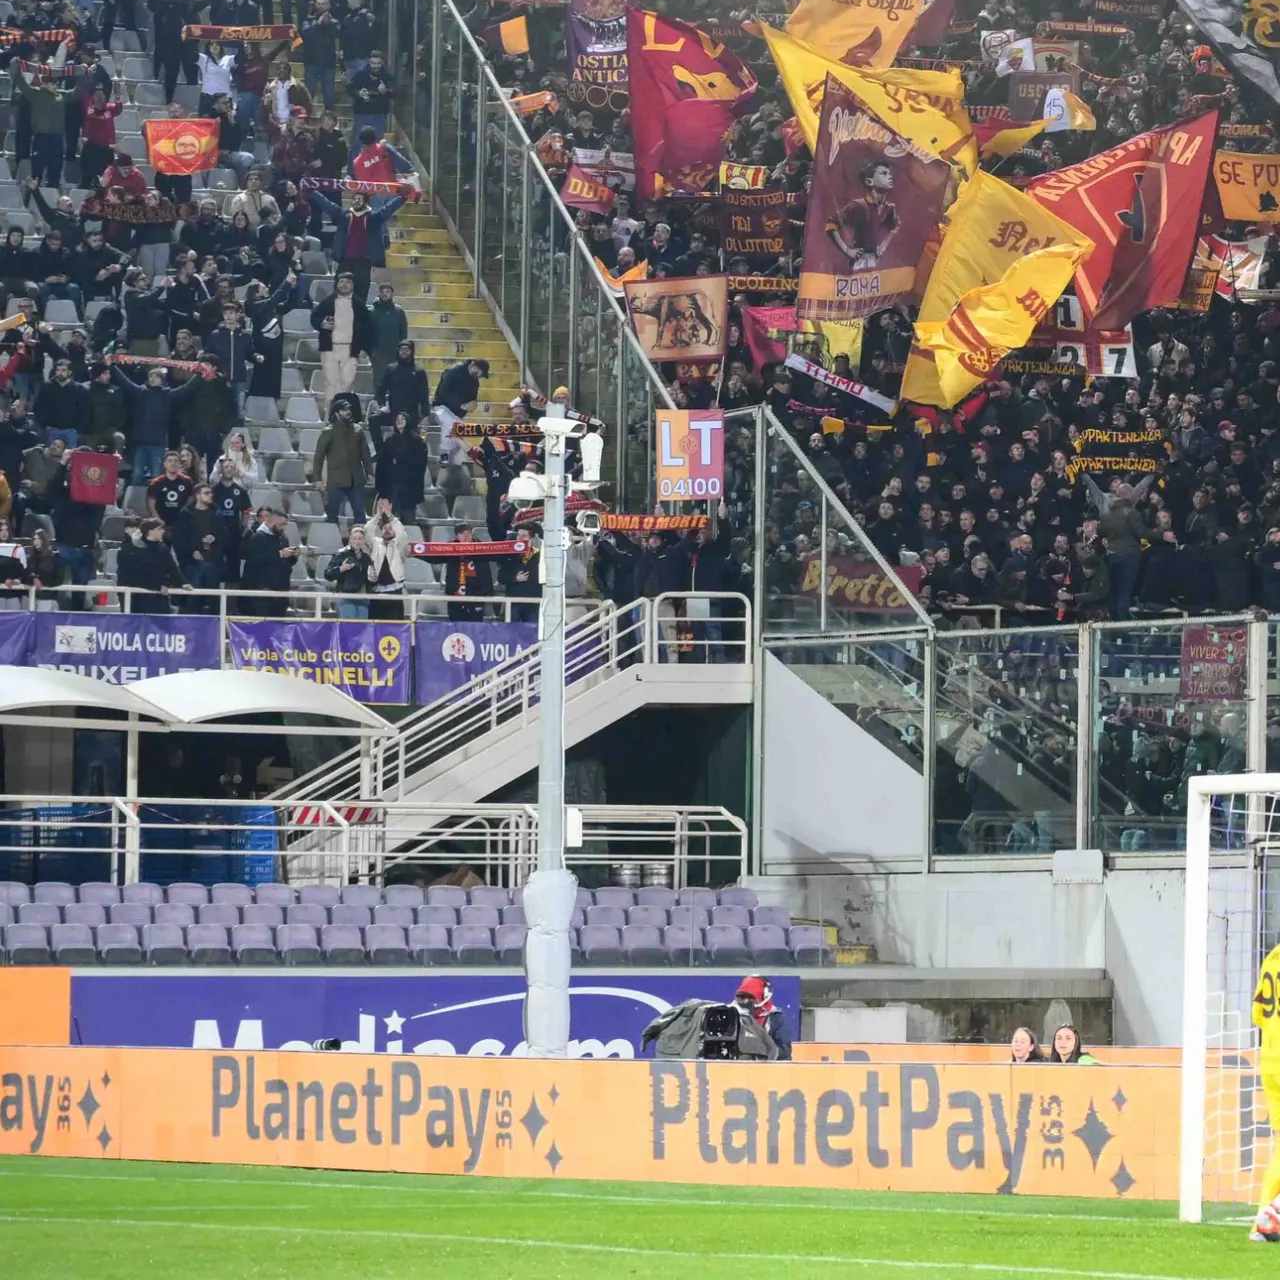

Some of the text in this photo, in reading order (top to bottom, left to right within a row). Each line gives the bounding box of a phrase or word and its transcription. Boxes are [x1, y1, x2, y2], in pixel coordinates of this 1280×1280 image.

[219, 26, 273, 40] ASROMA
[577, 55, 628, 68] OSTIA
[571, 68, 629, 83] ANTIC
[1218, 162, 1245, 186] SE
[299, 178, 392, 194] AS ROMA
[835, 275, 881, 299] ROMA
[1000, 360, 1077, 377] PARTENENZA
[1108, 347, 1128, 375] 7
[660, 477, 722, 497] 04100
[654, 515, 710, 529] MORTE
[430, 543, 453, 552] UNIONE
[98, 632, 187, 652] VIOLA CLUB
[241, 646, 376, 664] Viola Club Circolo
[1189, 645, 1217, 659] VIVER
[241, 666, 395, 687] ONCINELLI
[1187, 680, 1210, 696] STAR
[55, 1075, 74, 1133] 365
[211, 1054, 514, 1174] PlanetPay 365
[649, 1060, 1065, 1196] PlanetPay 365
